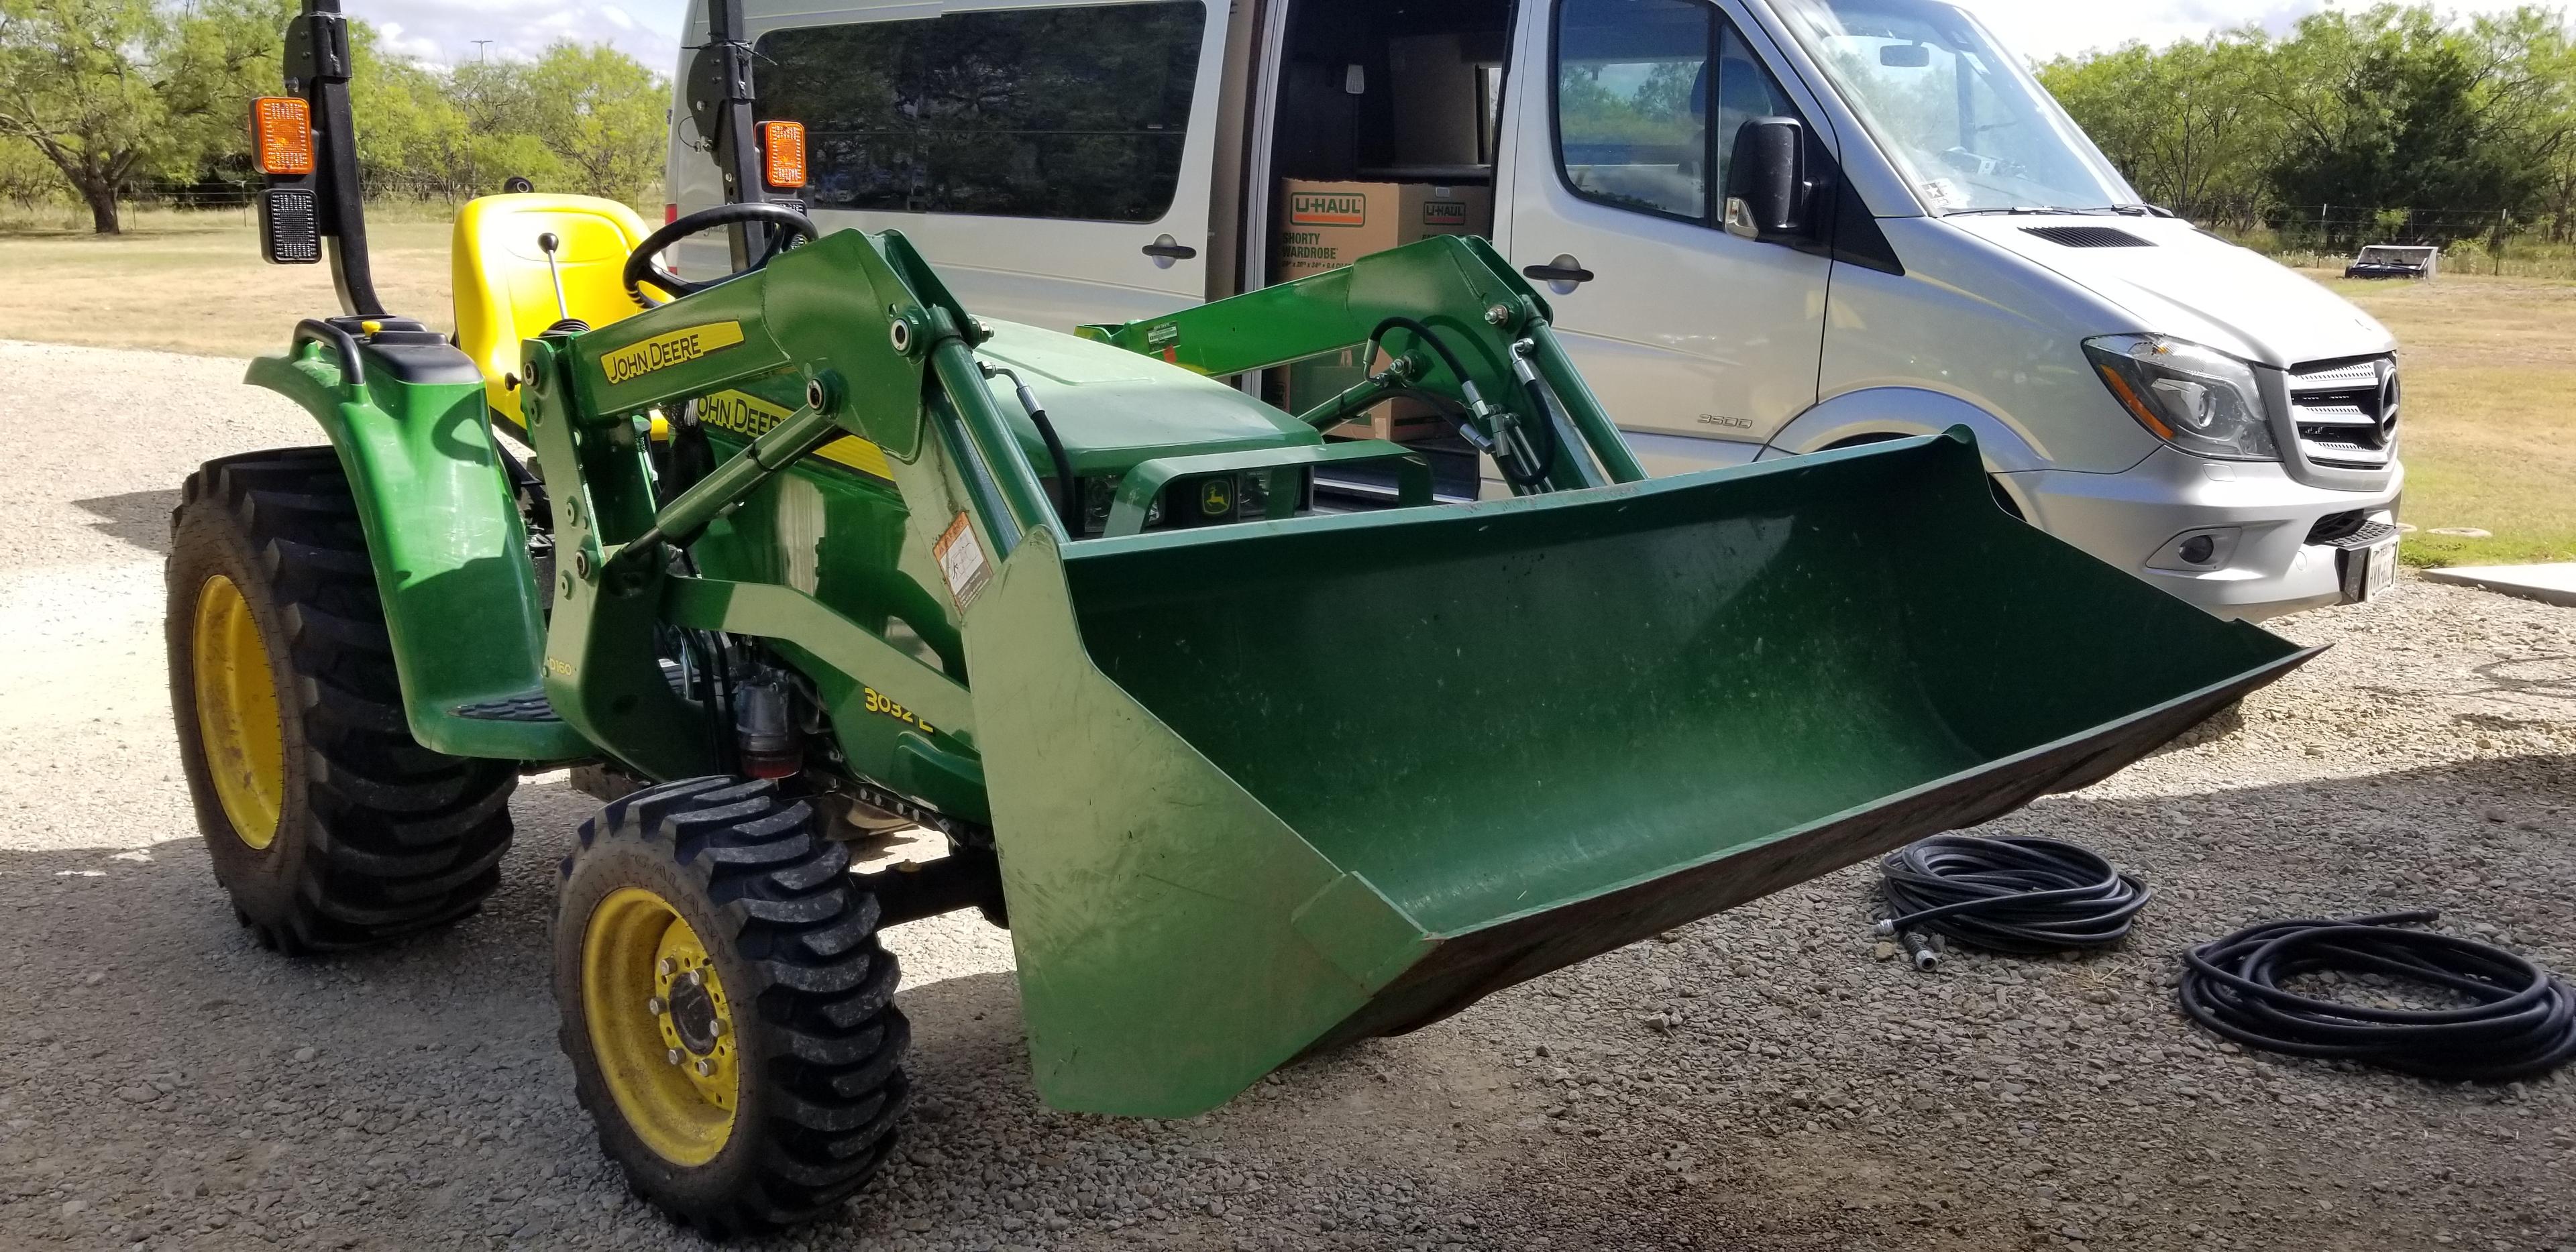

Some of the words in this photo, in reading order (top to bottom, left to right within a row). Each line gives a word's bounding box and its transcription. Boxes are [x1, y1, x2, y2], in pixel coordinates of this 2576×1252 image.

[1295, 198, 1360, 213] U-HAUL
[1427, 205, 1462, 216] U-HAUL
[1282, 232, 1320, 245] SHORTY
[1282, 245, 1336, 260] WARDROBE
[610, 351, 649, 381] JOHN
[649, 334, 701, 367] DEERE
[698, 396, 731, 425] OHN
[735, 398, 784, 436] DEER
[1697, 414, 1752, 429] 3500
[549, 657, 572, 677] D160
